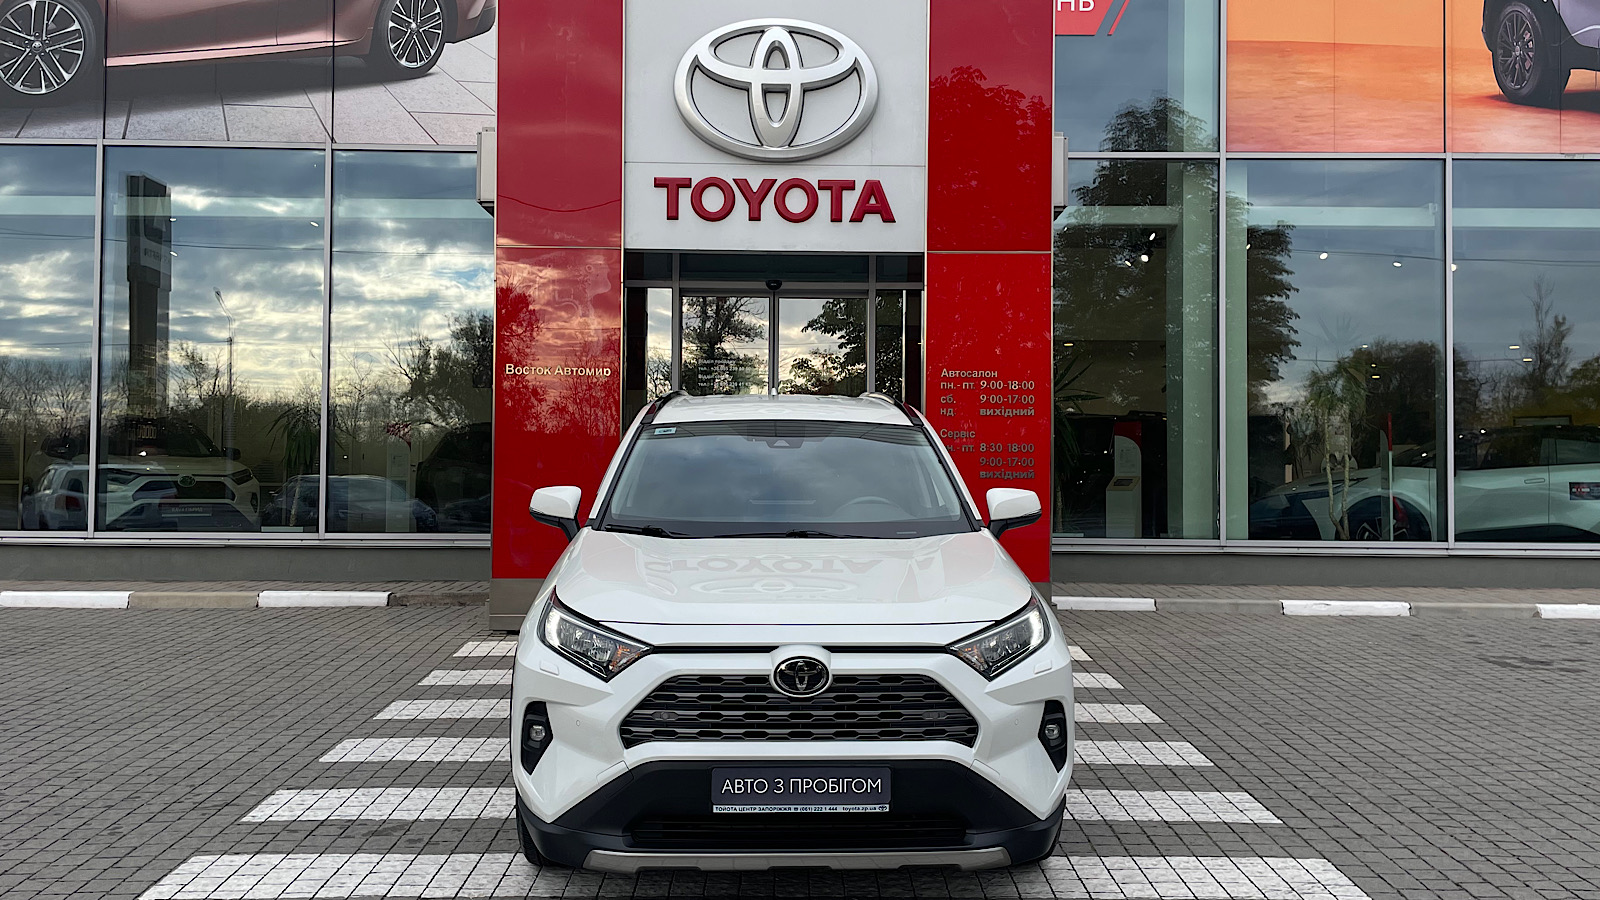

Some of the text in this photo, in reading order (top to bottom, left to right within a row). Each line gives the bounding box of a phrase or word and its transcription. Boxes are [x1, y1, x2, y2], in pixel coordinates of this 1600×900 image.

[654, 176, 896, 223] TOYOTA
[505, 363, 611, 379] Восток Автомир
[941, 368, 998, 378] Автосалон
[941, 394, 1035, 404] сб. 9:00-17:00
[940, 406, 1035, 418] нд. вихідний
[940, 429, 976, 439] Сервіс
[980, 457, 1035, 467] 9:00-17:00
[980, 468, 1035, 480] вихідний
[721, 778, 882, 794] АВТО З ПРОБІГОМ
